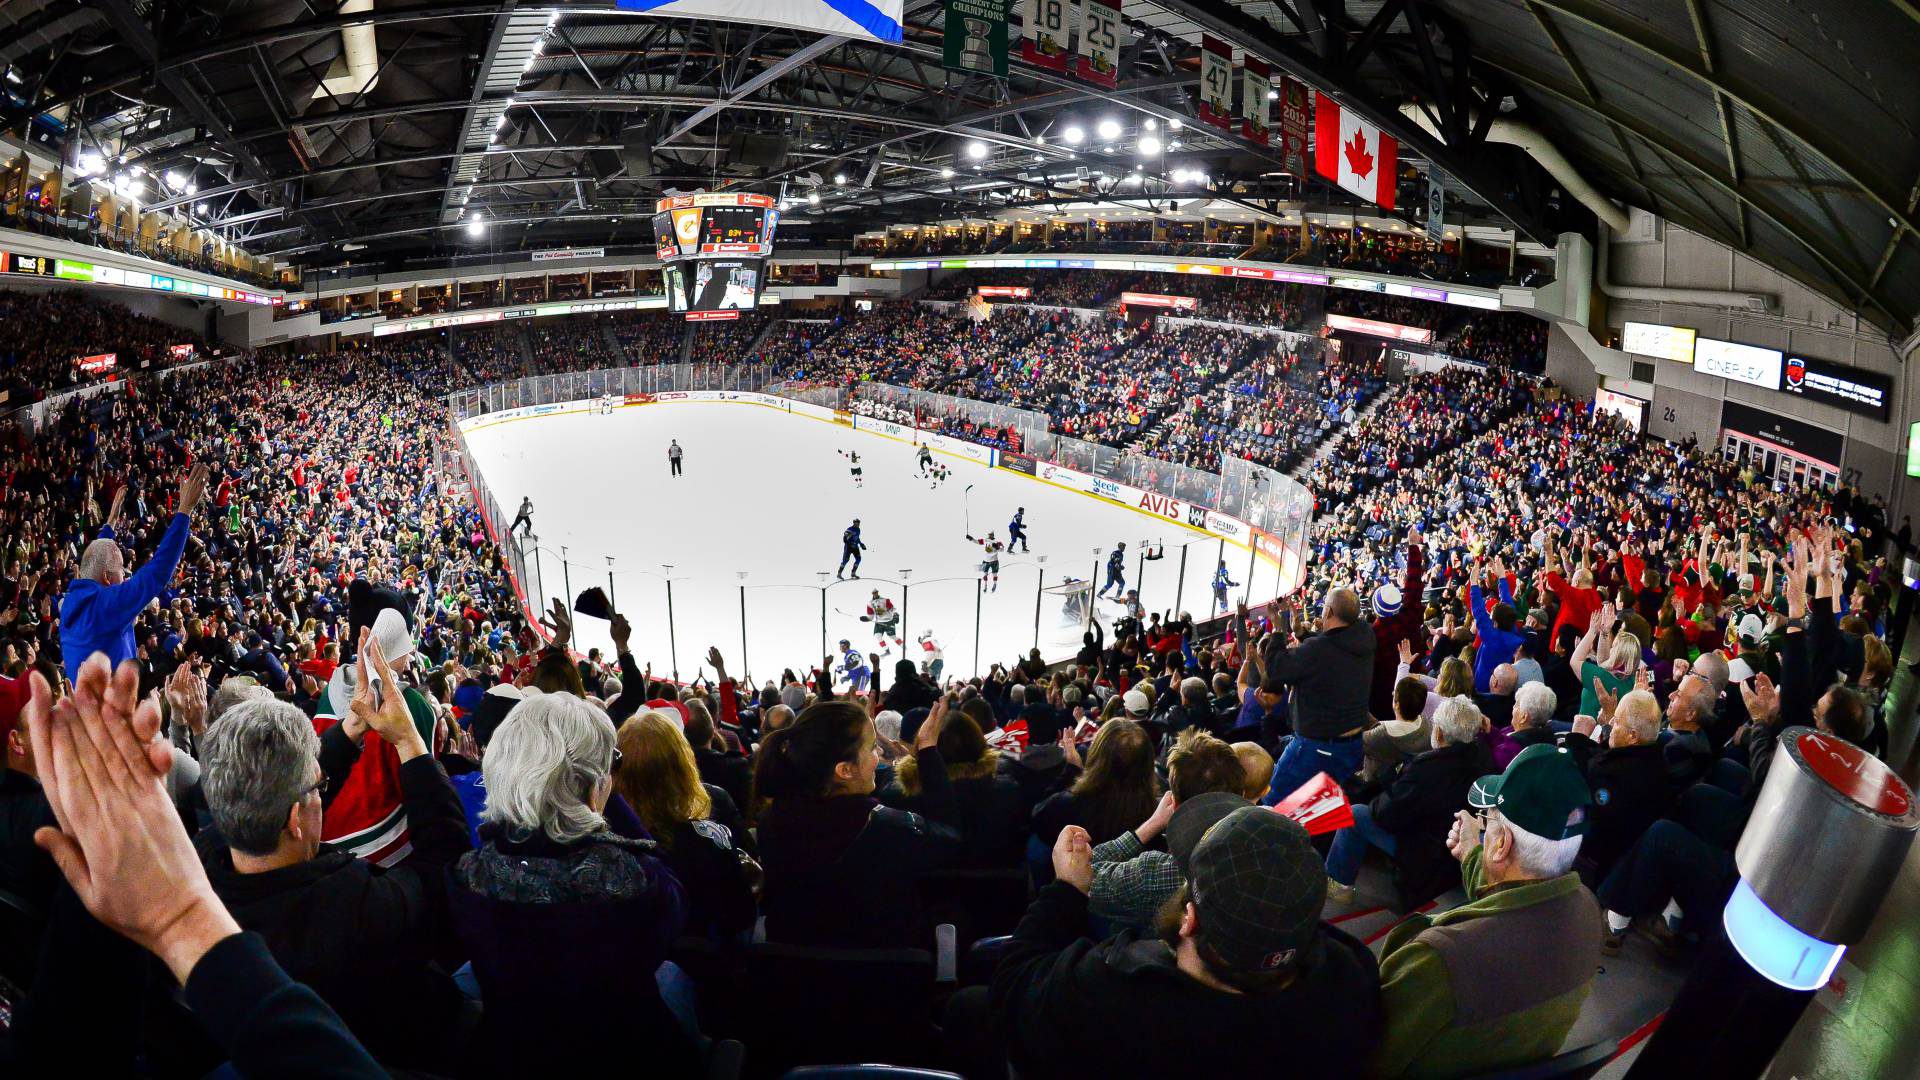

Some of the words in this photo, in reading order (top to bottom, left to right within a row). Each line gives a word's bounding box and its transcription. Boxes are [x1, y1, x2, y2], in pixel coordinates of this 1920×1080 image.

[952, 1, 1005, 22] CHAMPIONS
[991, 3, 1005, 11] CUP
[1034, 0, 1061, 30] 18
[1087, 14, 1115, 49] 25
[1206, 65, 1227, 96] 47
[1283, 105, 1306, 126] 2013
[1663, 406, 1676, 423] 26
[885, 424, 901, 436] MNP
[1093, 478, 1120, 494] Steele
[1138, 492, 1180, 519] AVIS
